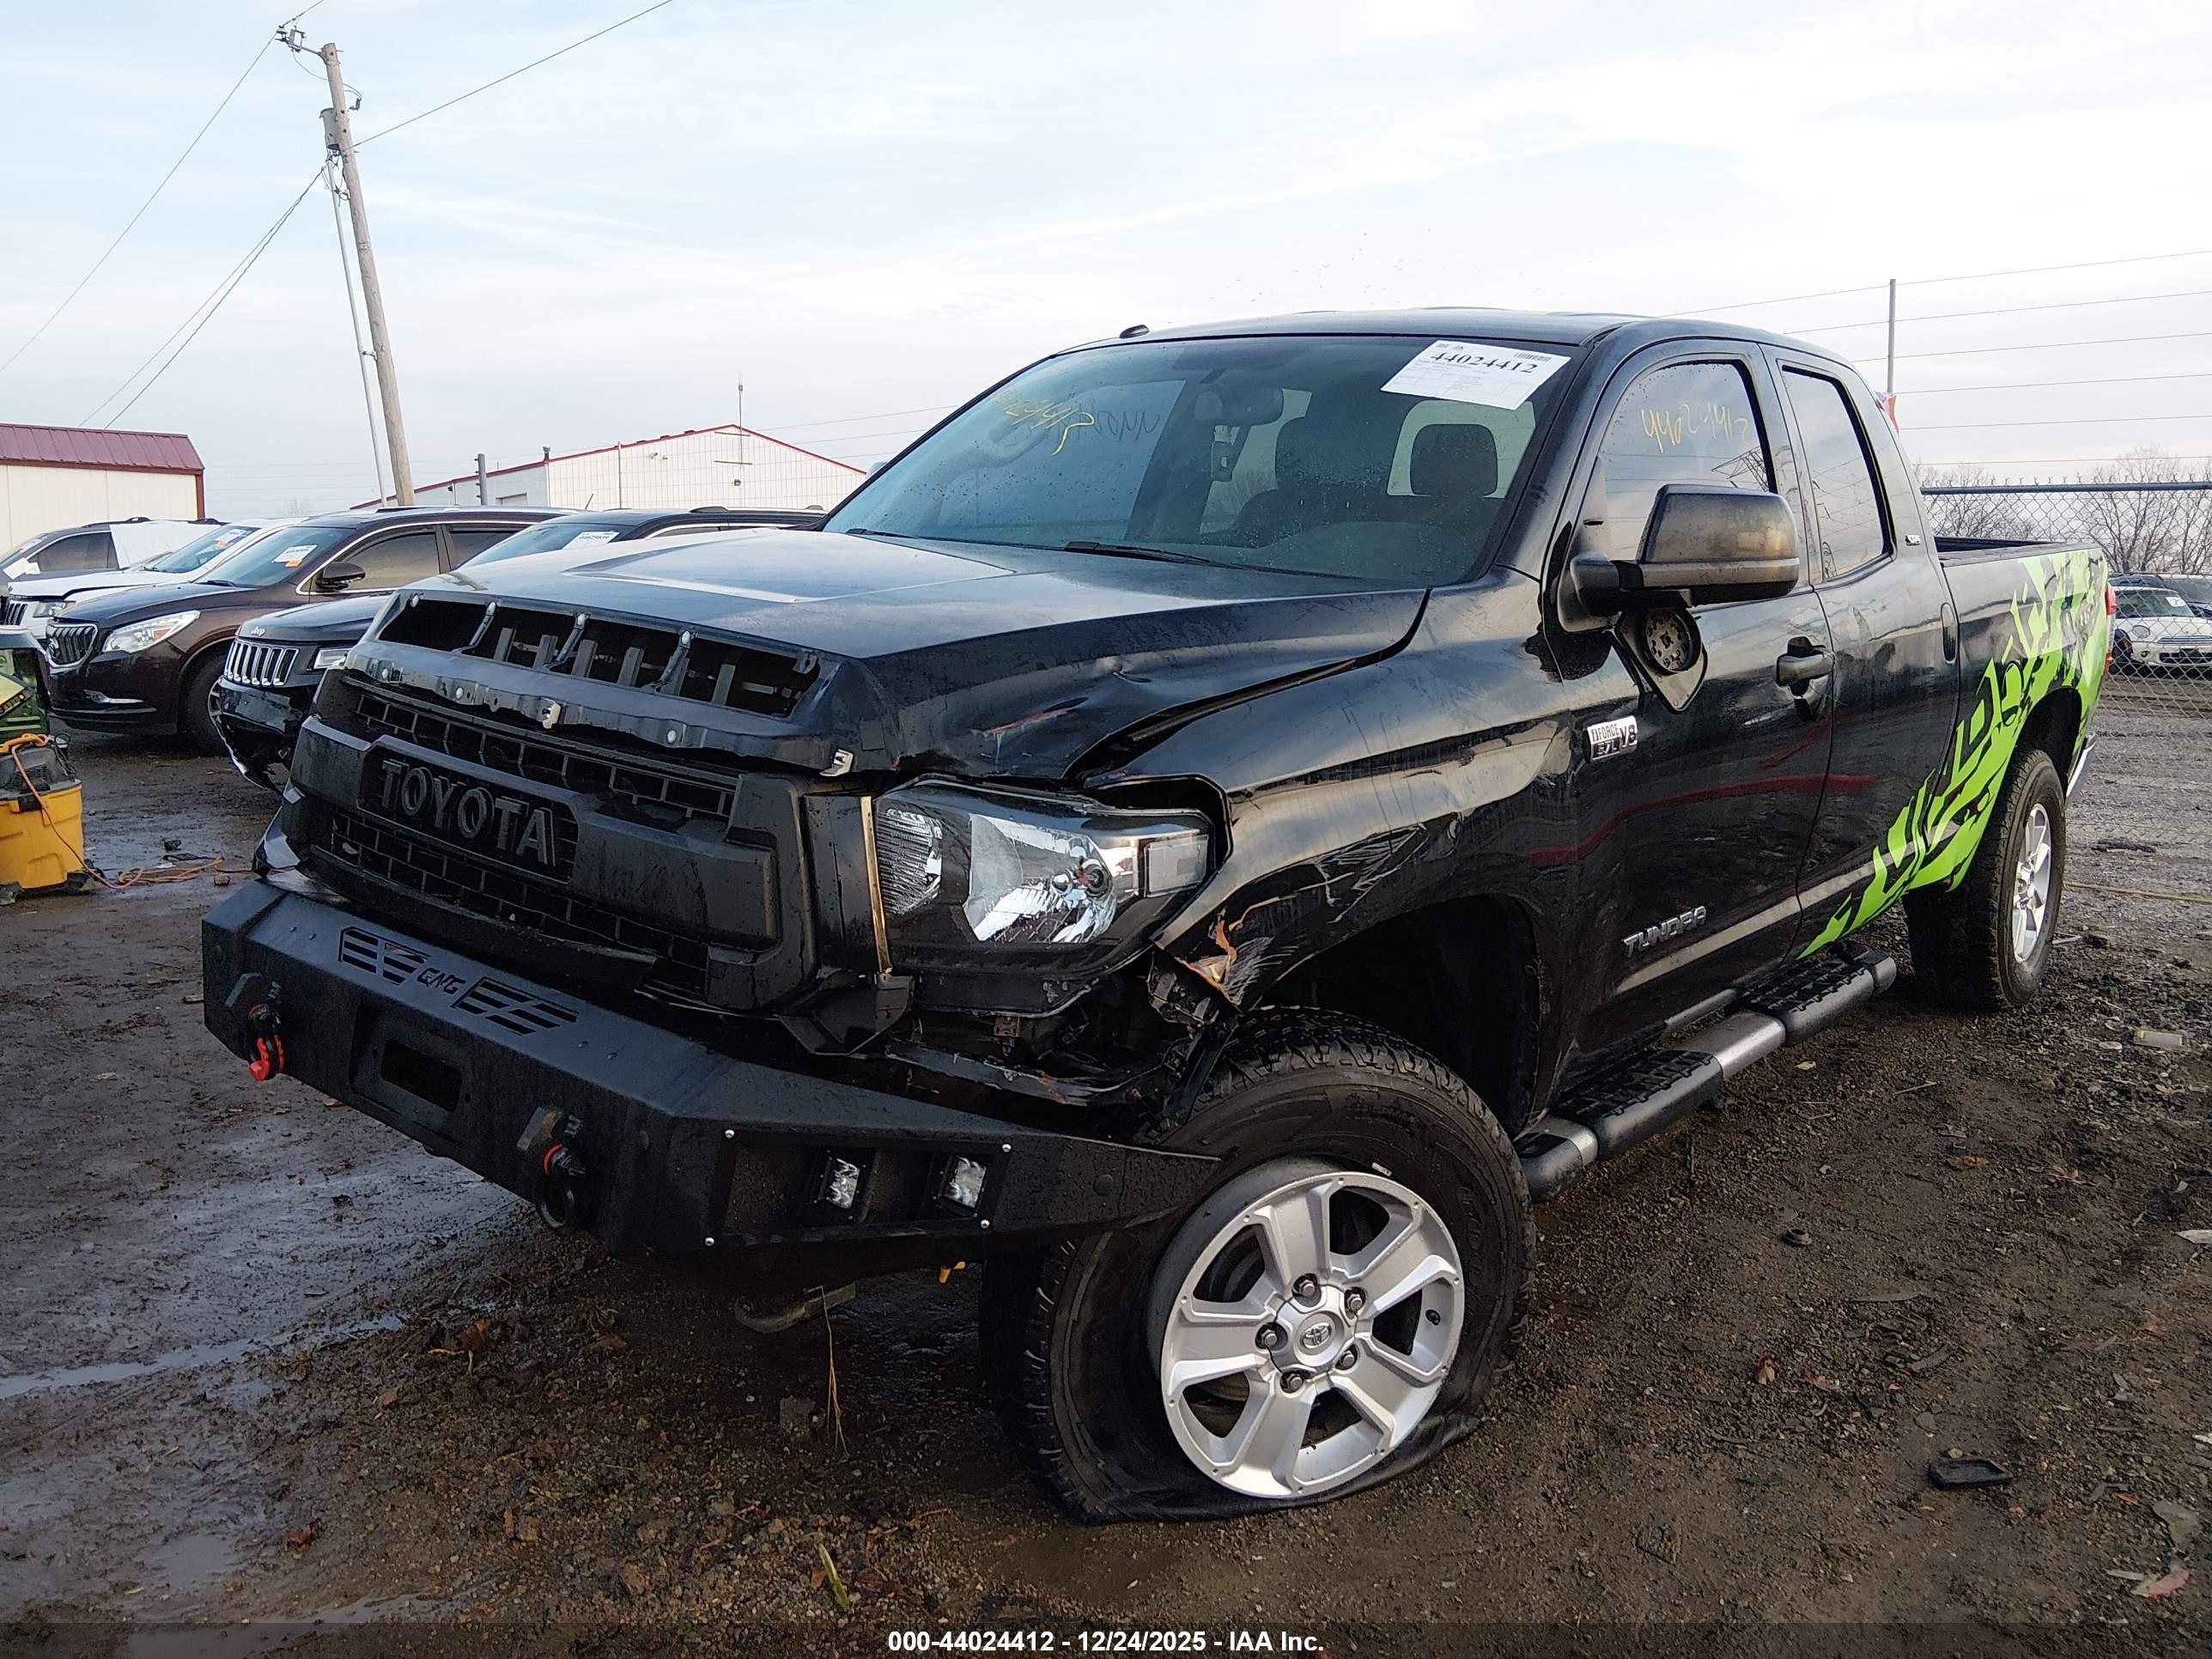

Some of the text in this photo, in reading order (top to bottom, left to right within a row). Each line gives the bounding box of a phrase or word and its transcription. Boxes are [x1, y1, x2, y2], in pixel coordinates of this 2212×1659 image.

[1431, 351, 1540, 374] 44024412
[1620, 724, 1637, 748] V8
[381, 758, 555, 866] TOYOTA
[1622, 905, 1707, 958] TUNDRA
